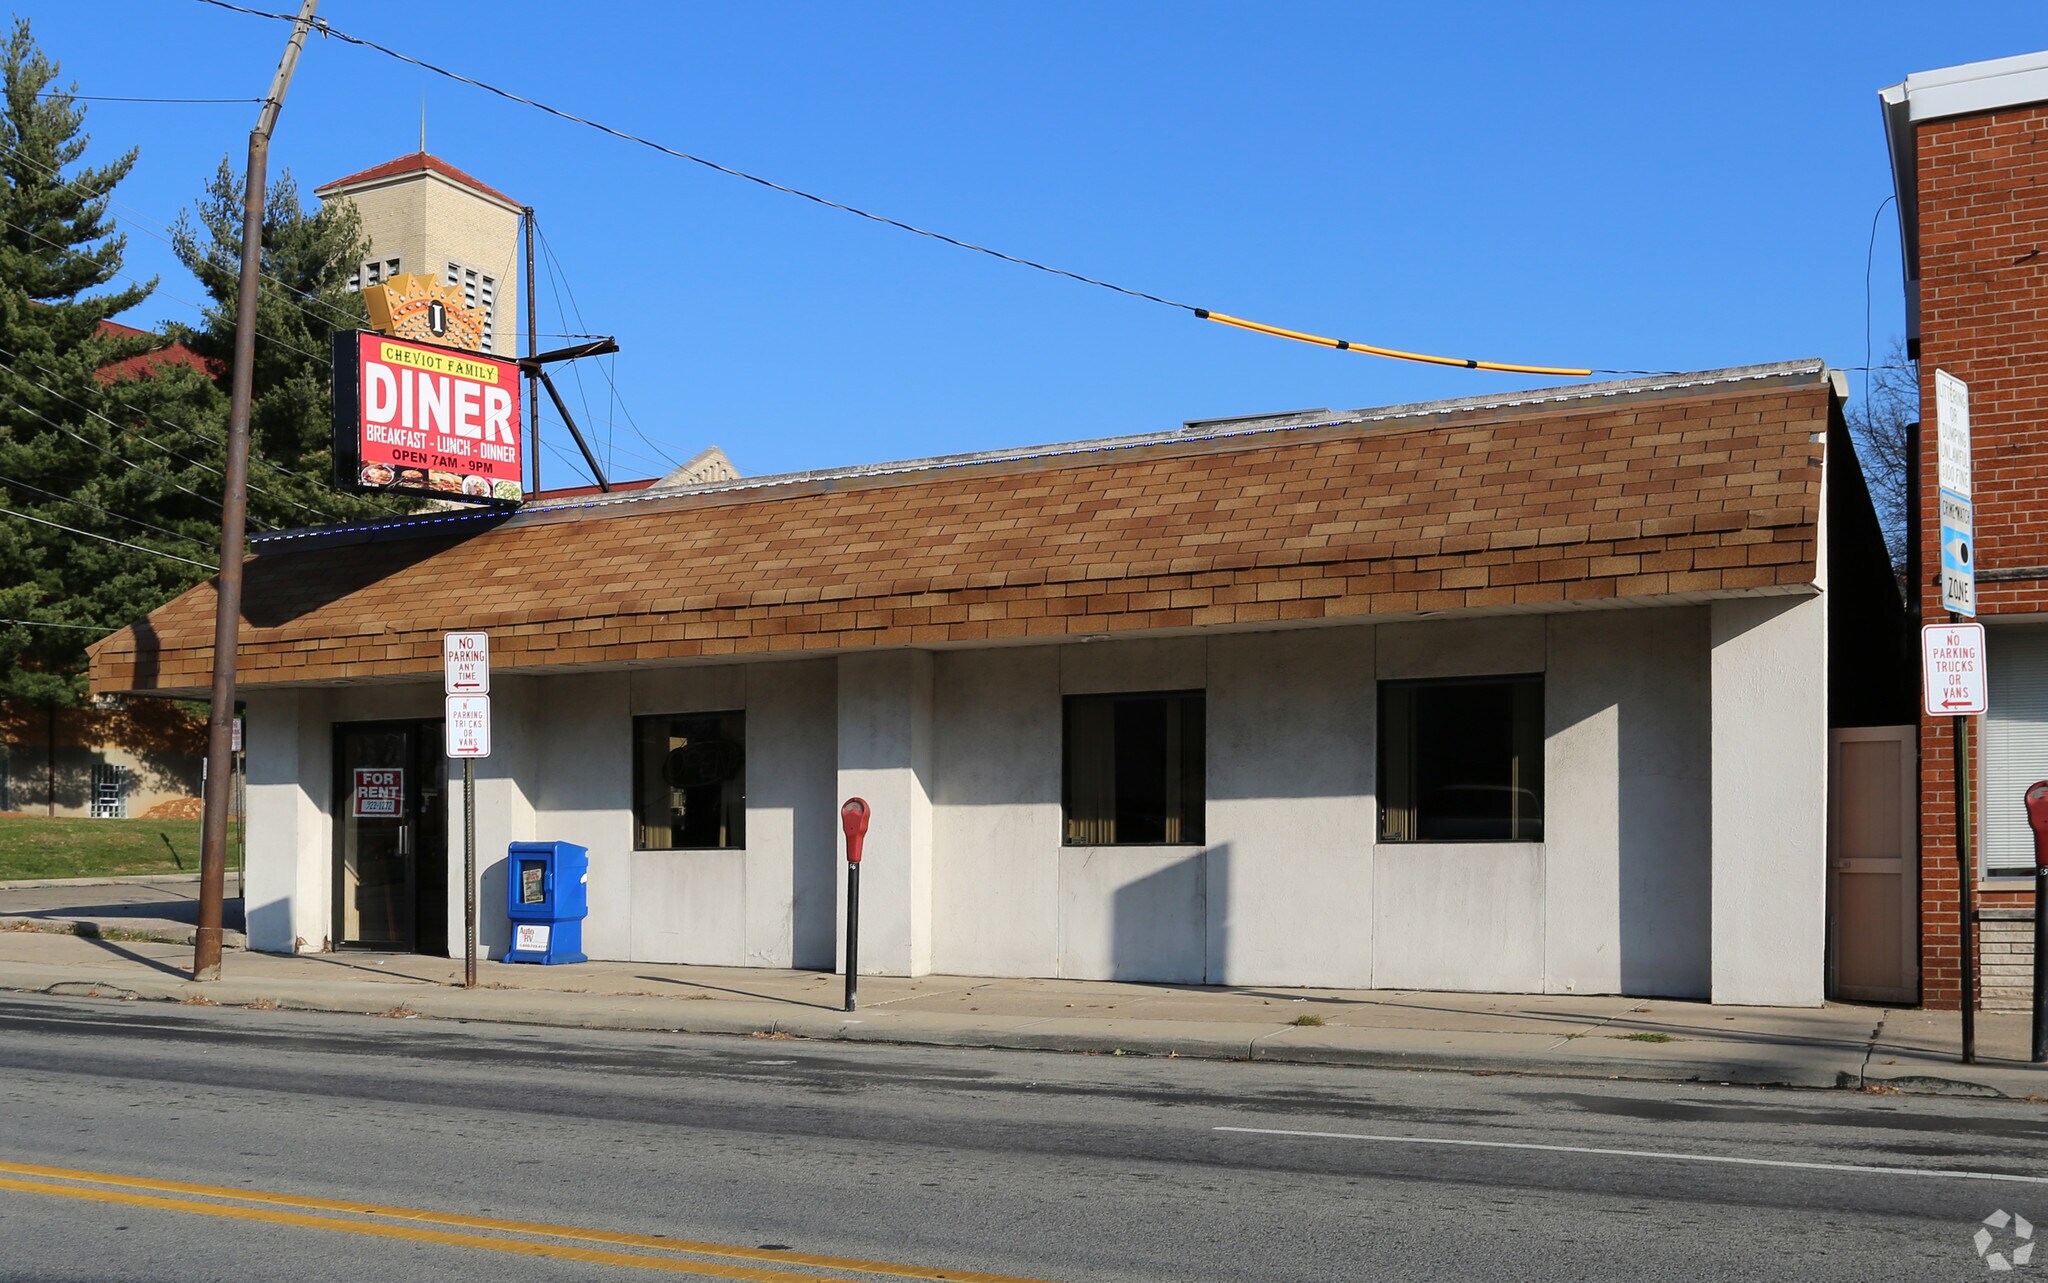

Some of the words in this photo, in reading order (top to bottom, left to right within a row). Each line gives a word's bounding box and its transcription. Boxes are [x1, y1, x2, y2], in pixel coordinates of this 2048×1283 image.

[386, 347, 442, 370] CHEVIOT
[448, 360, 494, 380] FAMILY
[365, 361, 515, 445] DINER
[366, 424, 427, 450] BREAKFAST
[437, 435, 471, 457] LUNCH
[480, 442, 516, 463] DINNER
[392, 449, 427, 464] OPEN
[431, 454, 458, 469] 7AM
[468, 461, 493, 474] 9PM
[1947, 576, 1969, 603] ZONE
[459, 638, 473, 650] NO
[1946, 634, 1960, 646] NO
[449, 650, 485, 662] PARKING
[1933, 647, 1976, 659] PARKING
[458, 663, 475, 671] ANY
[1936, 660, 1974, 673] TRUCKS
[458, 672, 476, 681] TIME
[1948, 674, 1962, 686] OR
[1943, 687, 1969, 699] VANS
[453, 710, 483, 719] PARKING
[463, 729, 473, 737] OR
[459, 738, 478, 746] VANS
[362, 772, 394, 785] FOR
[358, 786, 399, 798] RENT
[519, 927, 535, 935] Auto
